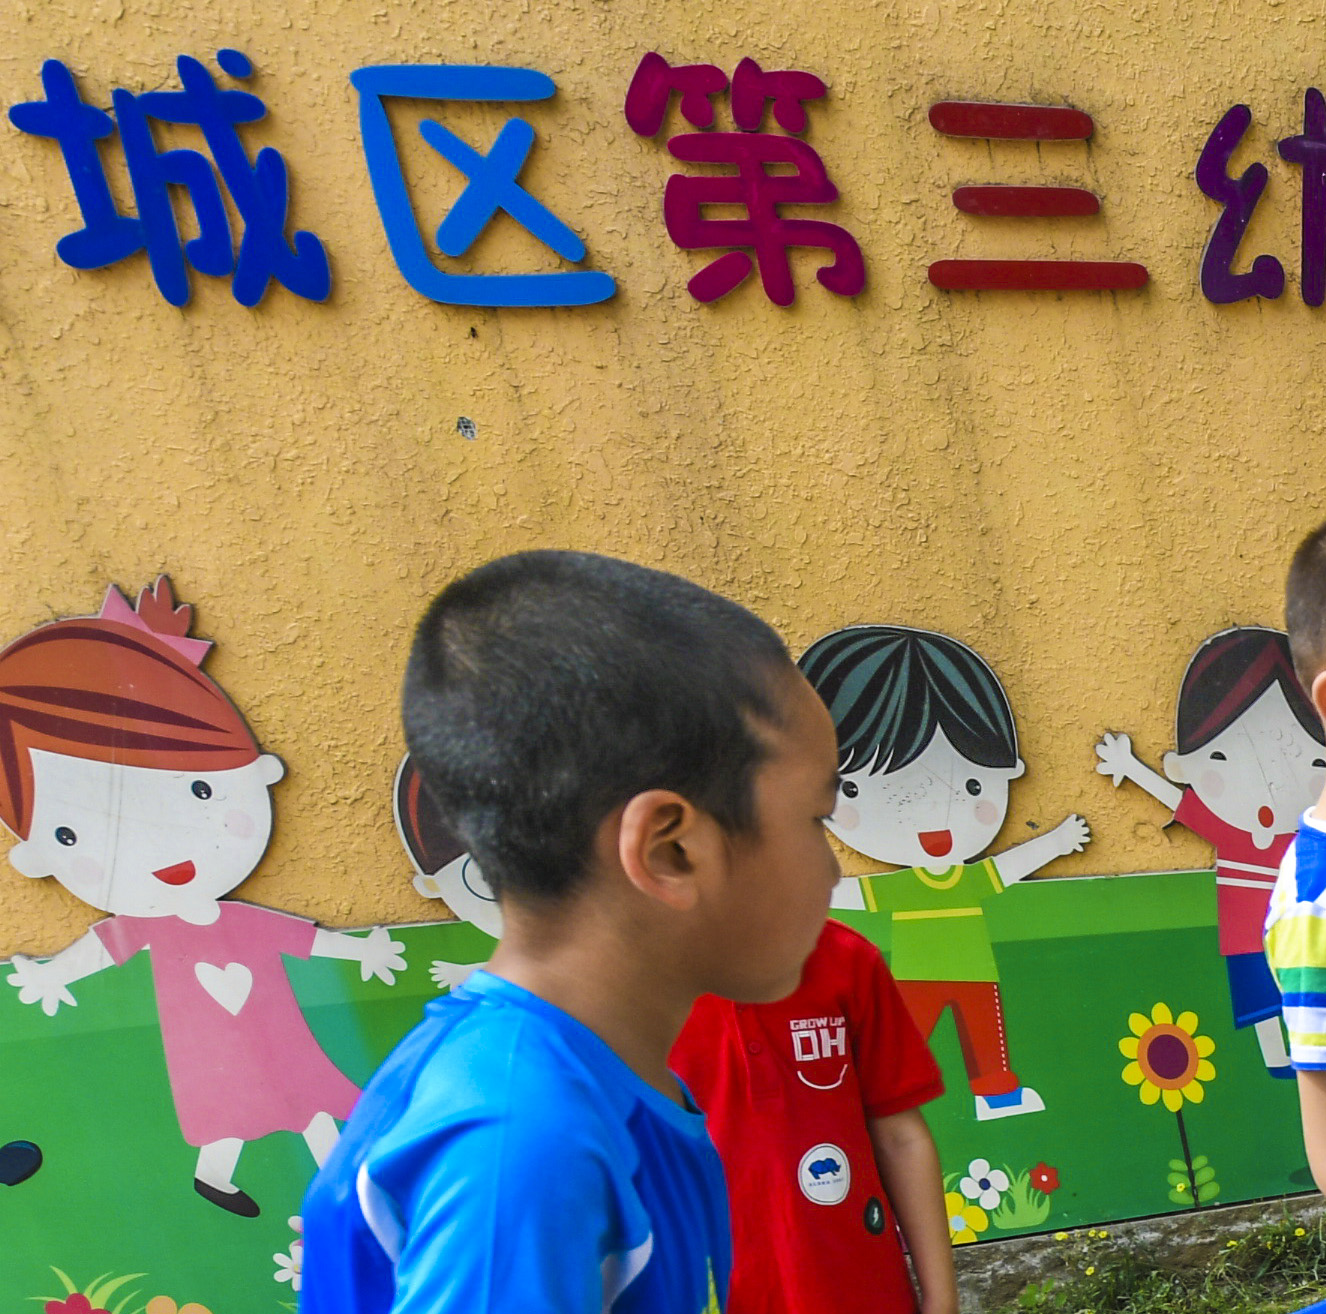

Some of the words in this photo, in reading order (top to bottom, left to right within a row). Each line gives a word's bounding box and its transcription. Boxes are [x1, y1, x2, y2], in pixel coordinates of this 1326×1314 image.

[790, 1017, 828, 1030] GROW
[828, 1016, 846, 1027] UP
[791, 1027, 847, 1062] OH
